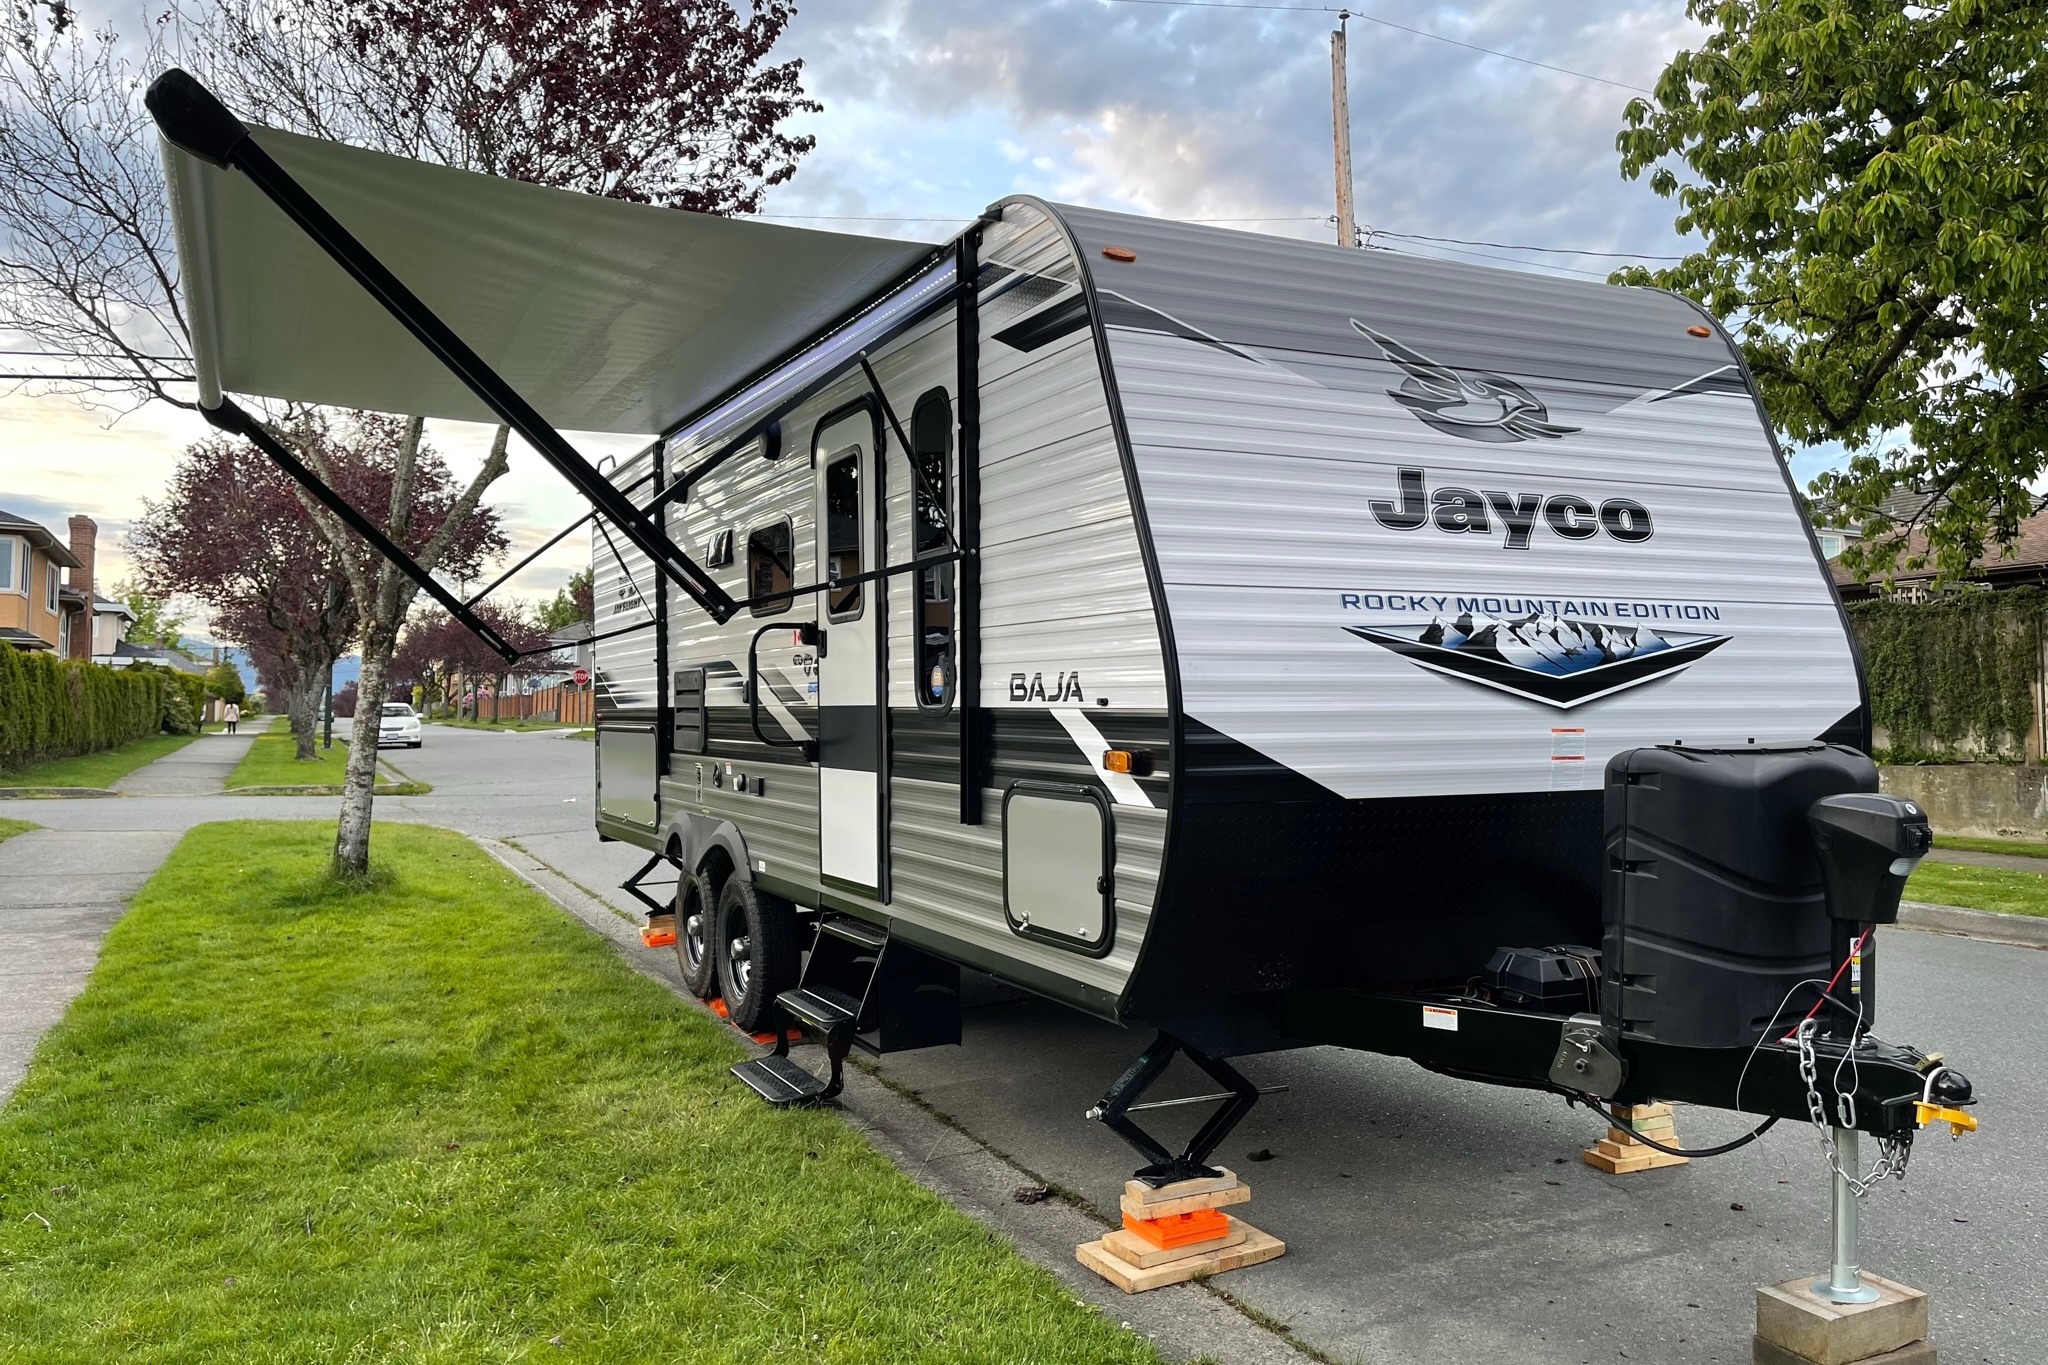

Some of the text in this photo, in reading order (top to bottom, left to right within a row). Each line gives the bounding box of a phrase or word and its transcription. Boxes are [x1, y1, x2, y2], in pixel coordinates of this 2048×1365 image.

[1368, 467, 1654, 550] Jayco
[1340, 593, 1720, 620] ROCKY MOUNTAIN EDITION
[573, 673, 589, 681] STOP
[1009, 671, 1084, 702] BAJA
